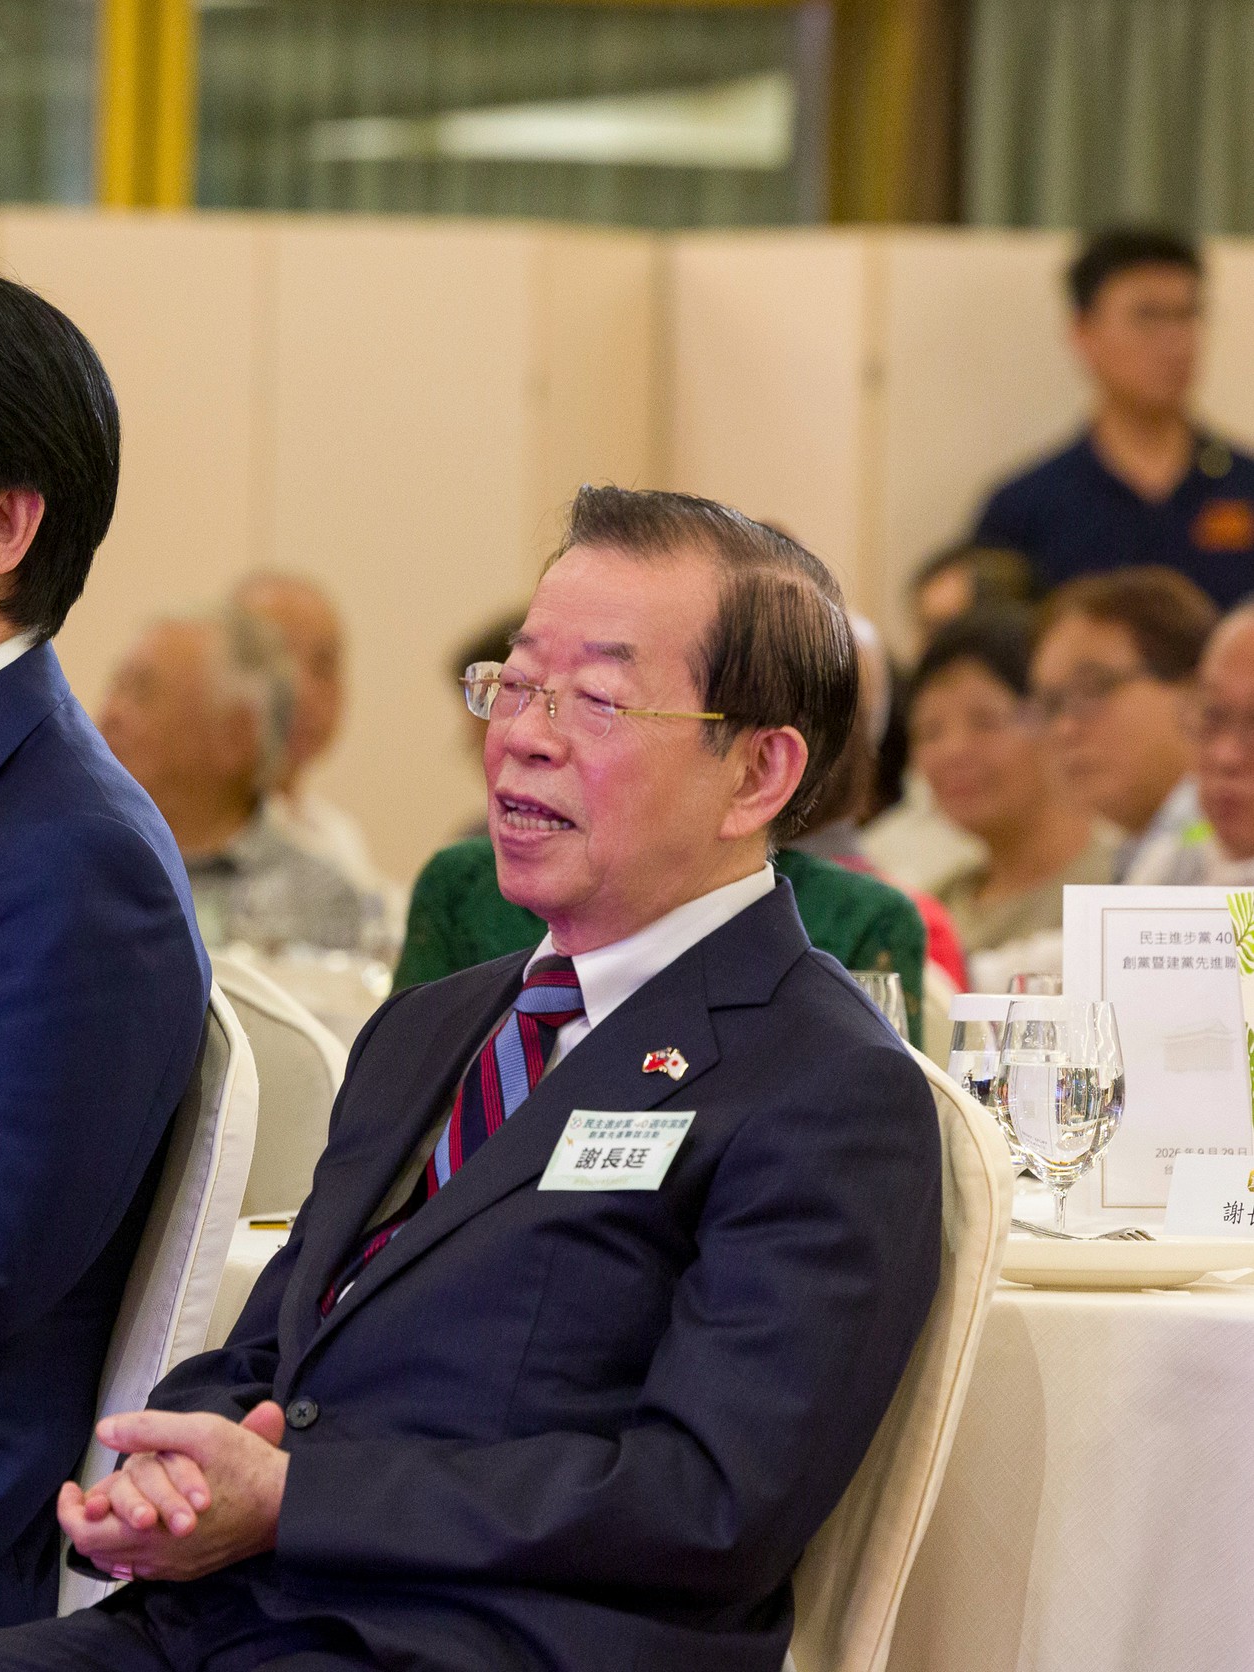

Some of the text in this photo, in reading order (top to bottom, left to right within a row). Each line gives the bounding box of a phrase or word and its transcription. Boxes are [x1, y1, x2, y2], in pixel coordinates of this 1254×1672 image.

[1140, 930, 1233, 945] 民主進步黨 40
[583, 1119, 634, 1129] 民主進步黨
[575, 1147, 651, 1169] 謝長廷
